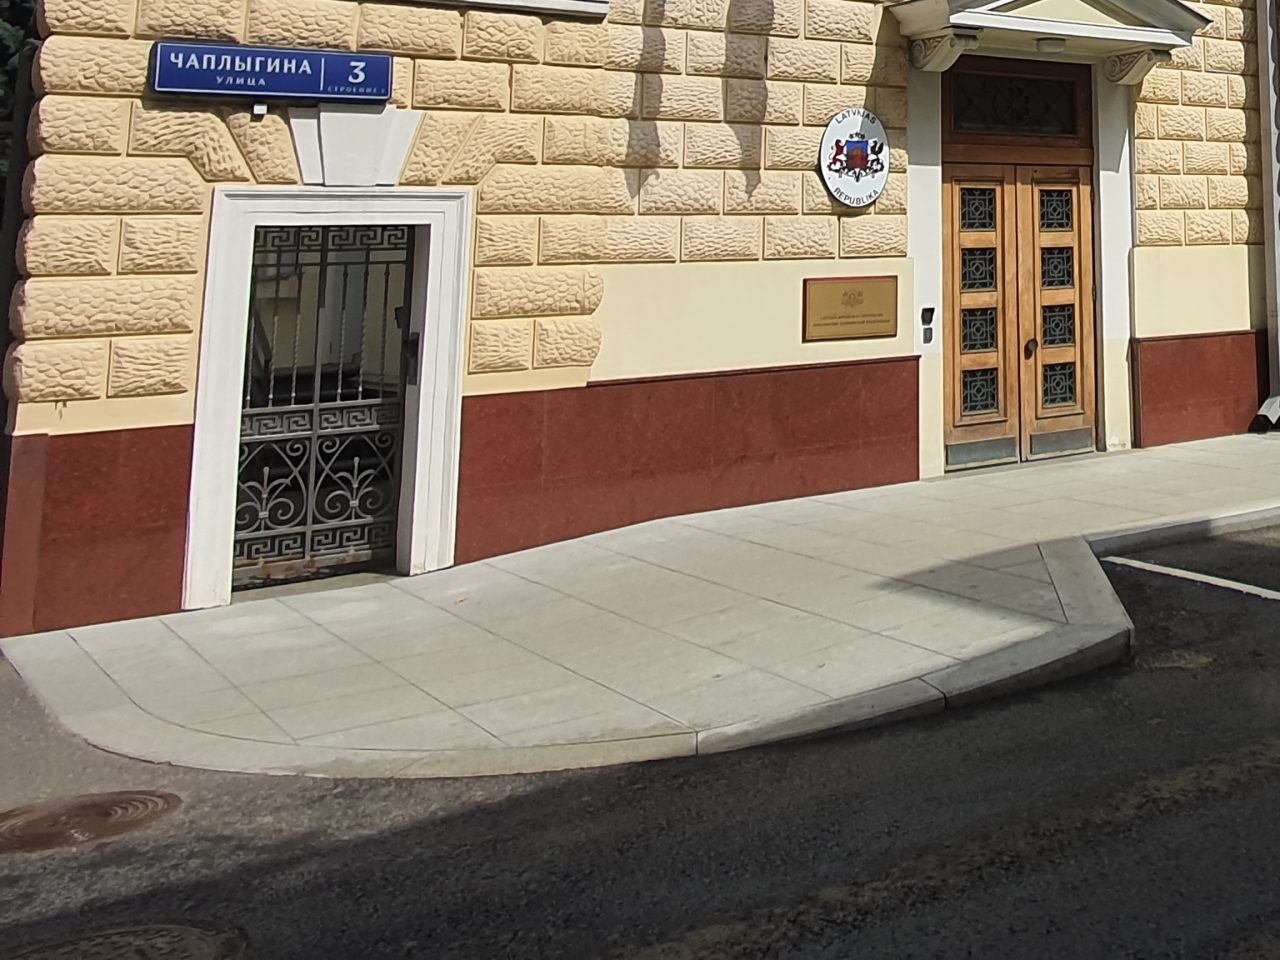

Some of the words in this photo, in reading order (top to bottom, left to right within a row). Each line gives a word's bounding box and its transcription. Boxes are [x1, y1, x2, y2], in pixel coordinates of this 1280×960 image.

[170, 52, 312, 75] ЧАПЛЫГИНА
[348, 61, 366, 83] 3
[215, 75, 266, 86] УЛИЦА
[835, 109, 876, 124] LATVIJAS
[833, 187, 879, 205] REPUBLIKA
